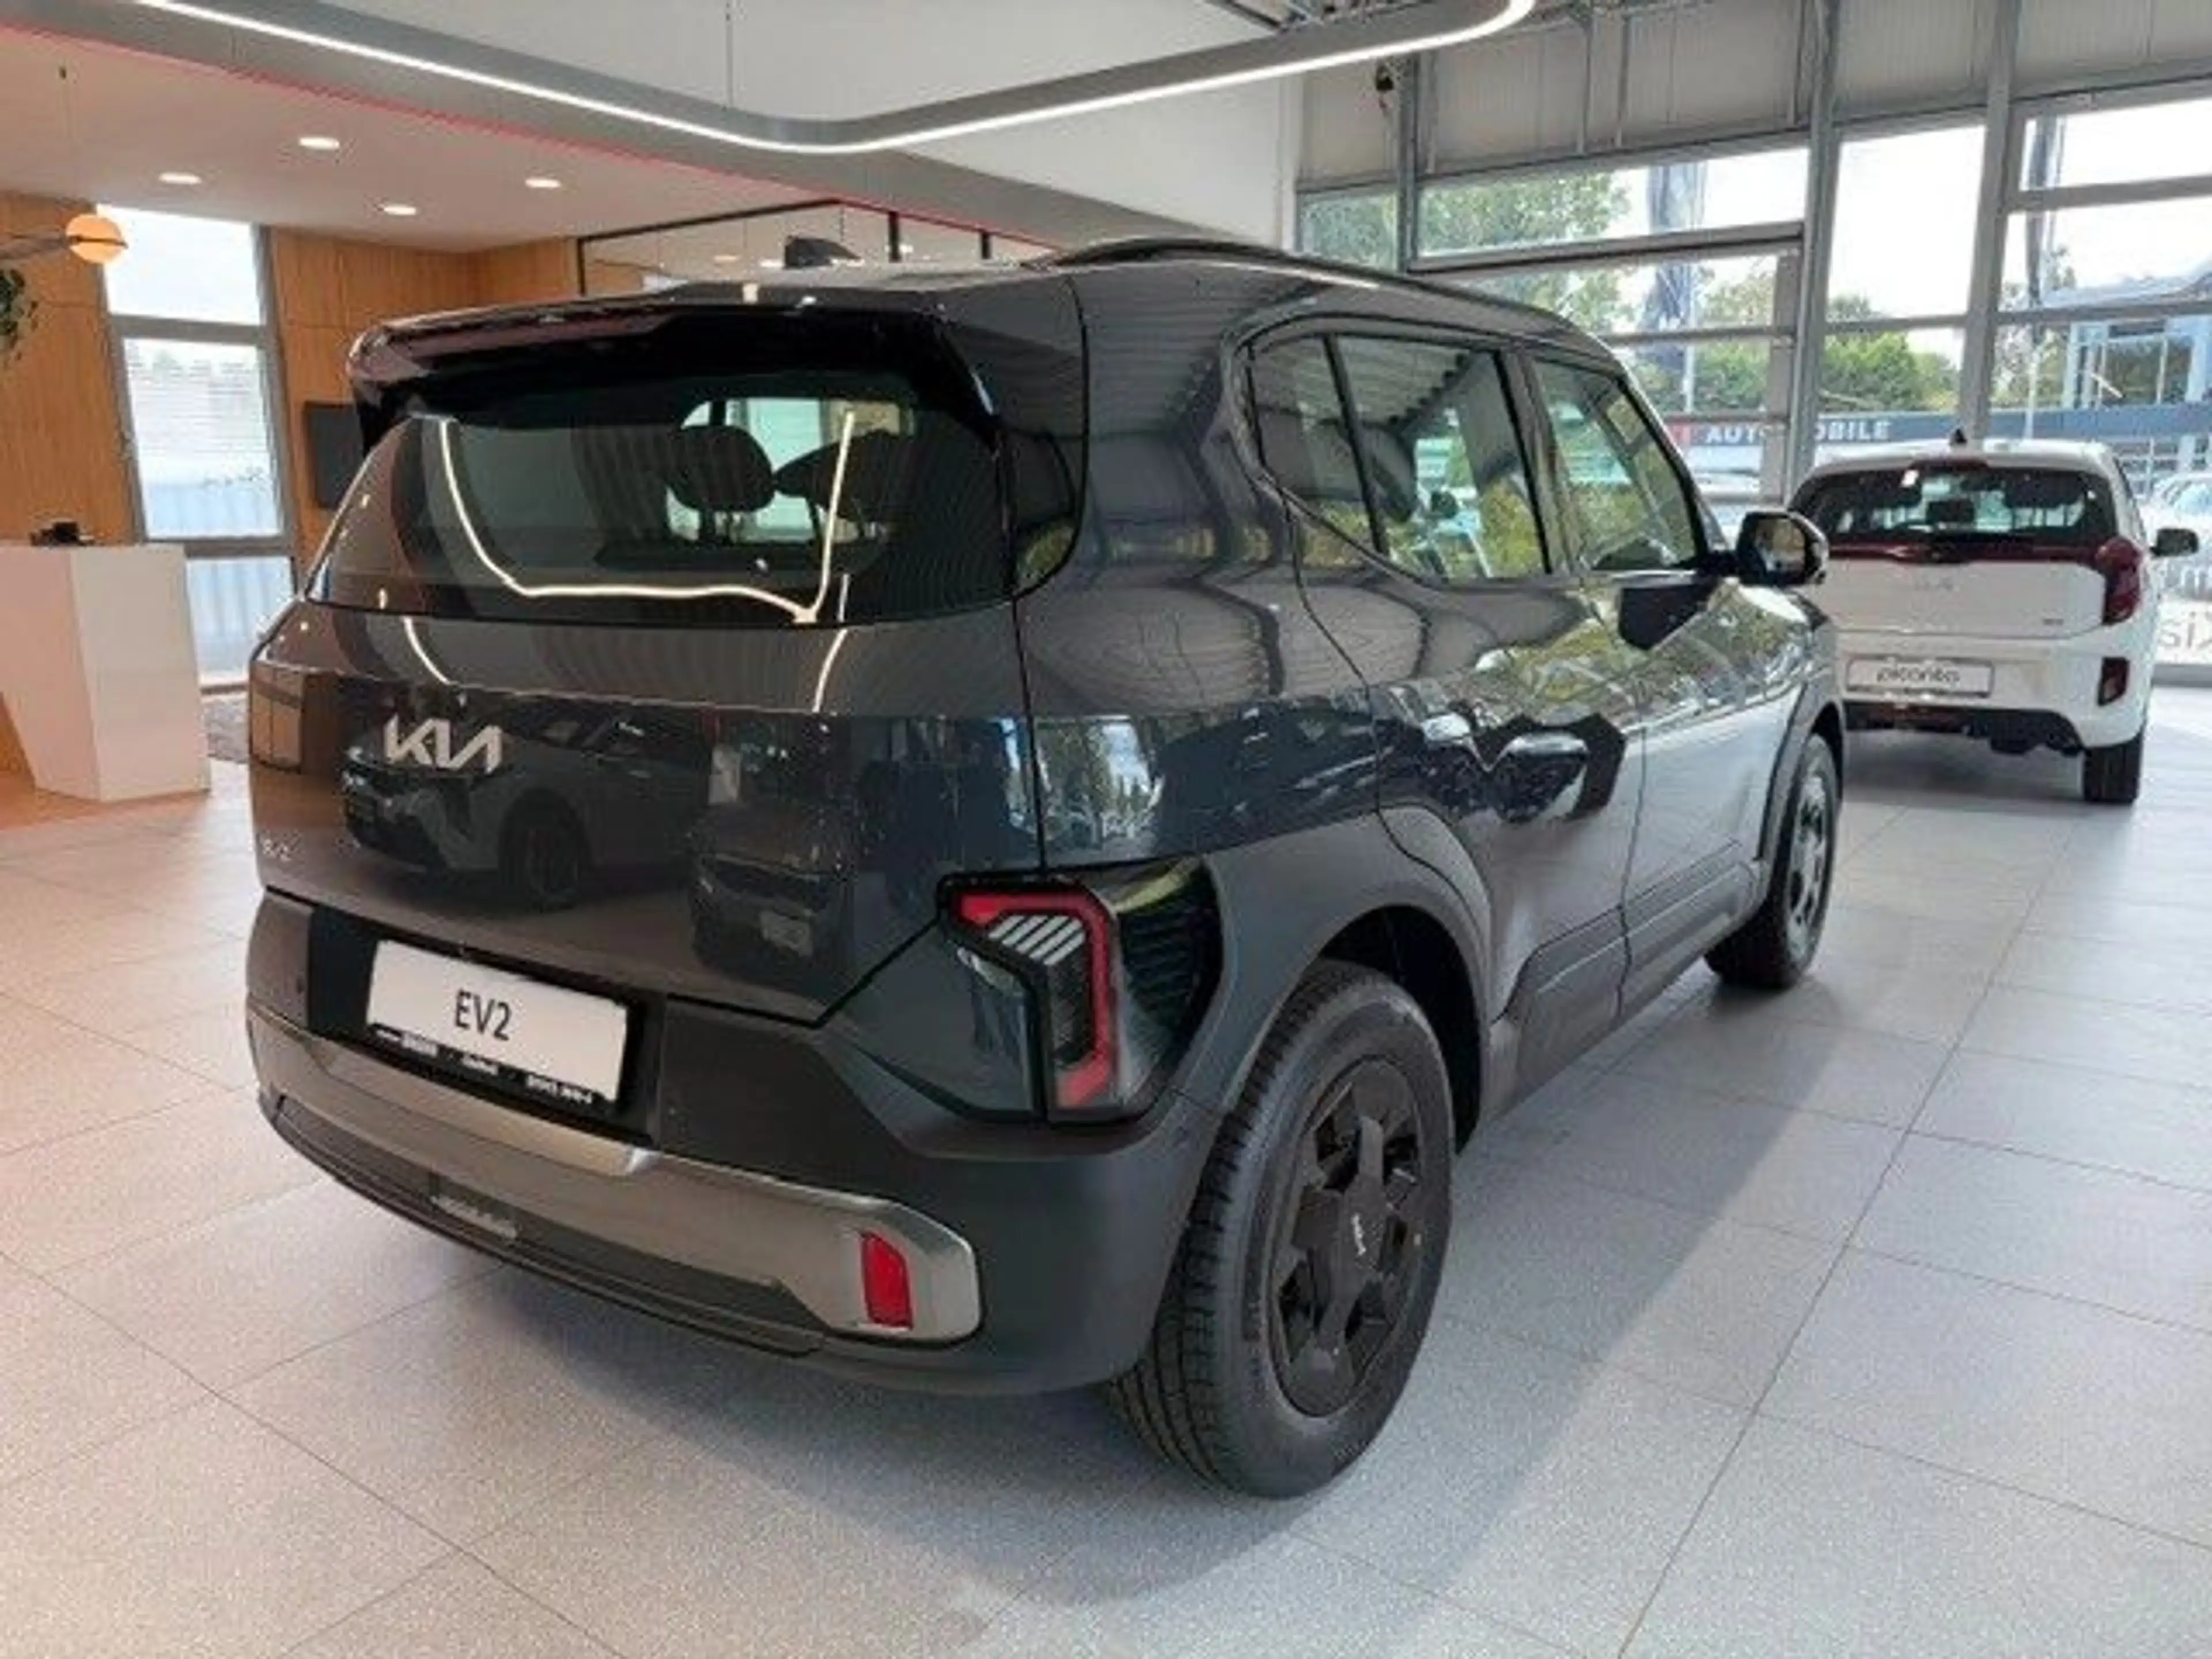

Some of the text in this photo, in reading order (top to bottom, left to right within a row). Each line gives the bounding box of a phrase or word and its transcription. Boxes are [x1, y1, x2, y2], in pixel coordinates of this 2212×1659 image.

[1706, 421, 1892, 443] AUTOBILE
[383, 713, 503, 774] KIA
[454, 987, 512, 1041] EV2
